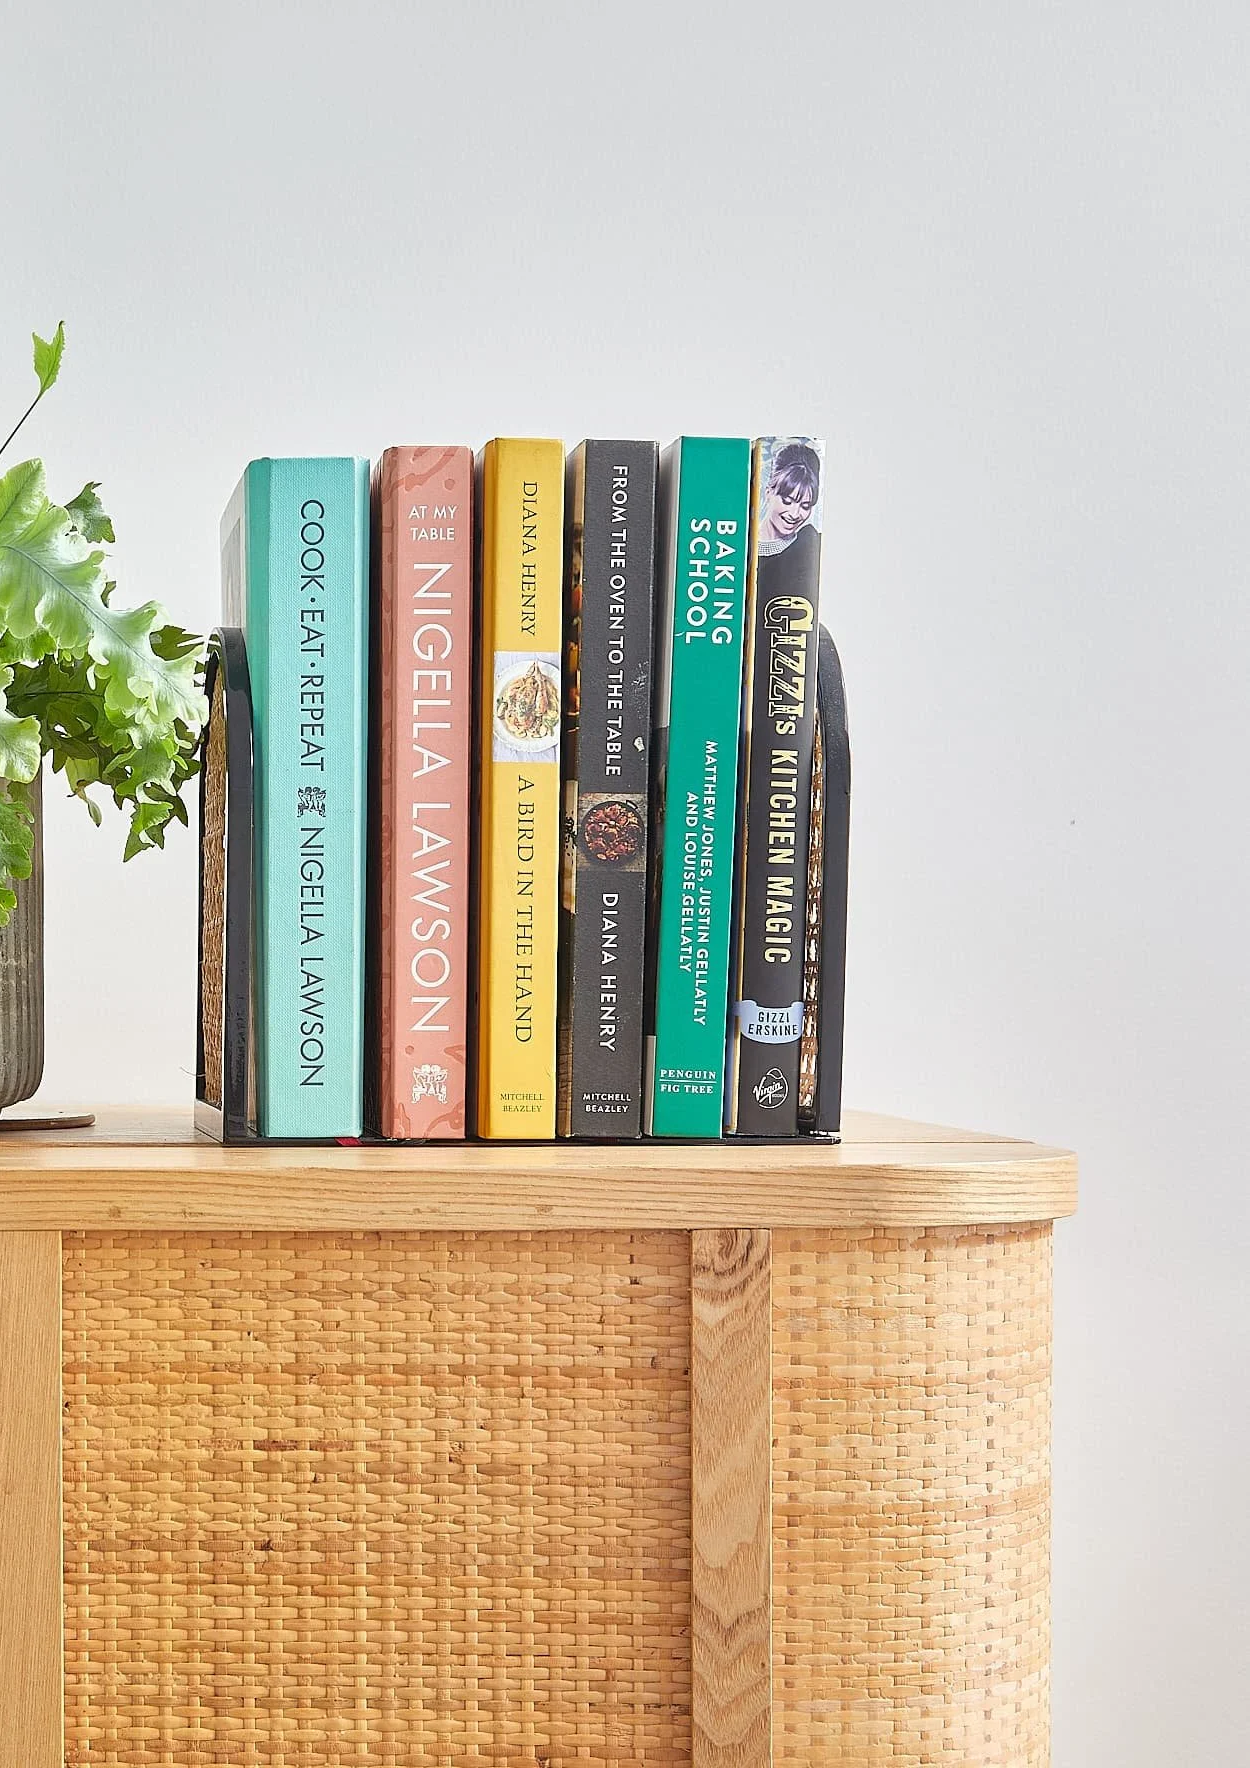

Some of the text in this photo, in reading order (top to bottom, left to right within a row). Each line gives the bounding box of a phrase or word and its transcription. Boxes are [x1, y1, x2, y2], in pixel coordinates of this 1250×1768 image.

[408, 505, 458, 520] AT MY
[411, 527, 455, 541] TABLE
[521, 481, 538, 636] DIANA HENRY
[686, 519, 711, 644] SCHOOL
[712, 520, 737, 645] BAKING
[605, 465, 628, 776] FROM THE OVEN TO THE TABLE
[410, 563, 453, 1032] NIGELLA LAWSON
[768, 749, 799, 864] KITCHEN
[515, 775, 535, 1043] A BIRD IN THE HAND
[679, 792, 699, 973] AND LOUISE GELLATLY
[693, 741, 718, 1026] MATTHEW JONES, JUSTIN GELLATLY
[764, 876, 794, 963] MAGIC
[299, 826, 326, 1087] NIGELLA LAWSON
[599, 893, 619, 1052] DIANA HENRY
[747, 1024, 799, 1036] ERSKINE
[758, 1011, 790, 1023] GIZZI
[500, 1092, 545, 1101] MITCHELL
[503, 1105, 542, 1113] BEAZLEY
[583, 1093, 631, 1102] MITCHELL
[585, 1104, 629, 1113] BEAZLEY
[660, 1069, 717, 1080] PENGUIN
[660, 1084, 714, 1094] FIG TREE
[753, 1076, 784, 1104] Virgin
